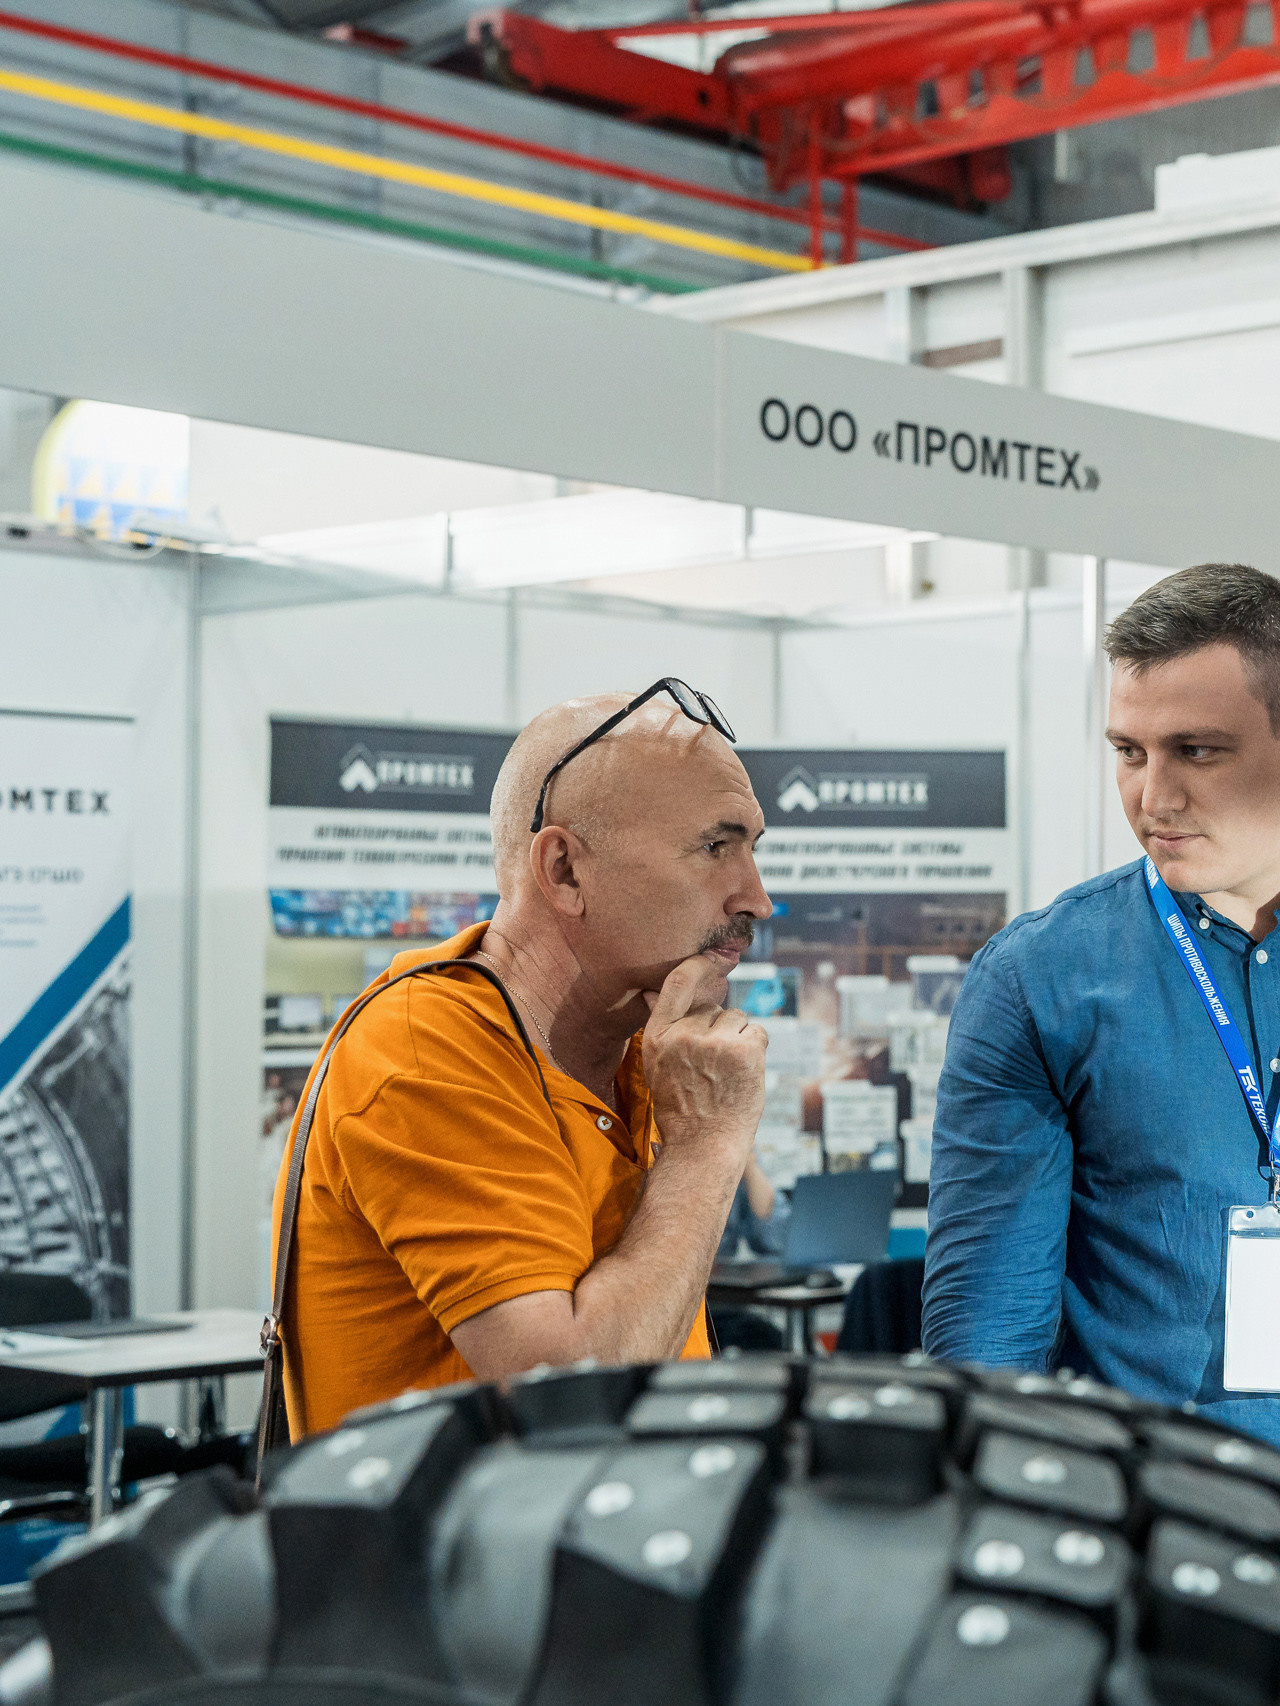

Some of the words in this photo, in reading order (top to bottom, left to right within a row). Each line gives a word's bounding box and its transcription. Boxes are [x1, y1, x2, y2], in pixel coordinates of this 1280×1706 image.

[760, 397, 858, 453] ООО
[872, 420, 1101, 492] «ПРОМТЕХ»
[0, 788, 109, 816] МТЕХ
[1166, 913, 1188, 940] ШИПЫ
[1178, 936, 1230, 1026] ПРОТИВОСКОЛЬЖЕНИЯ
